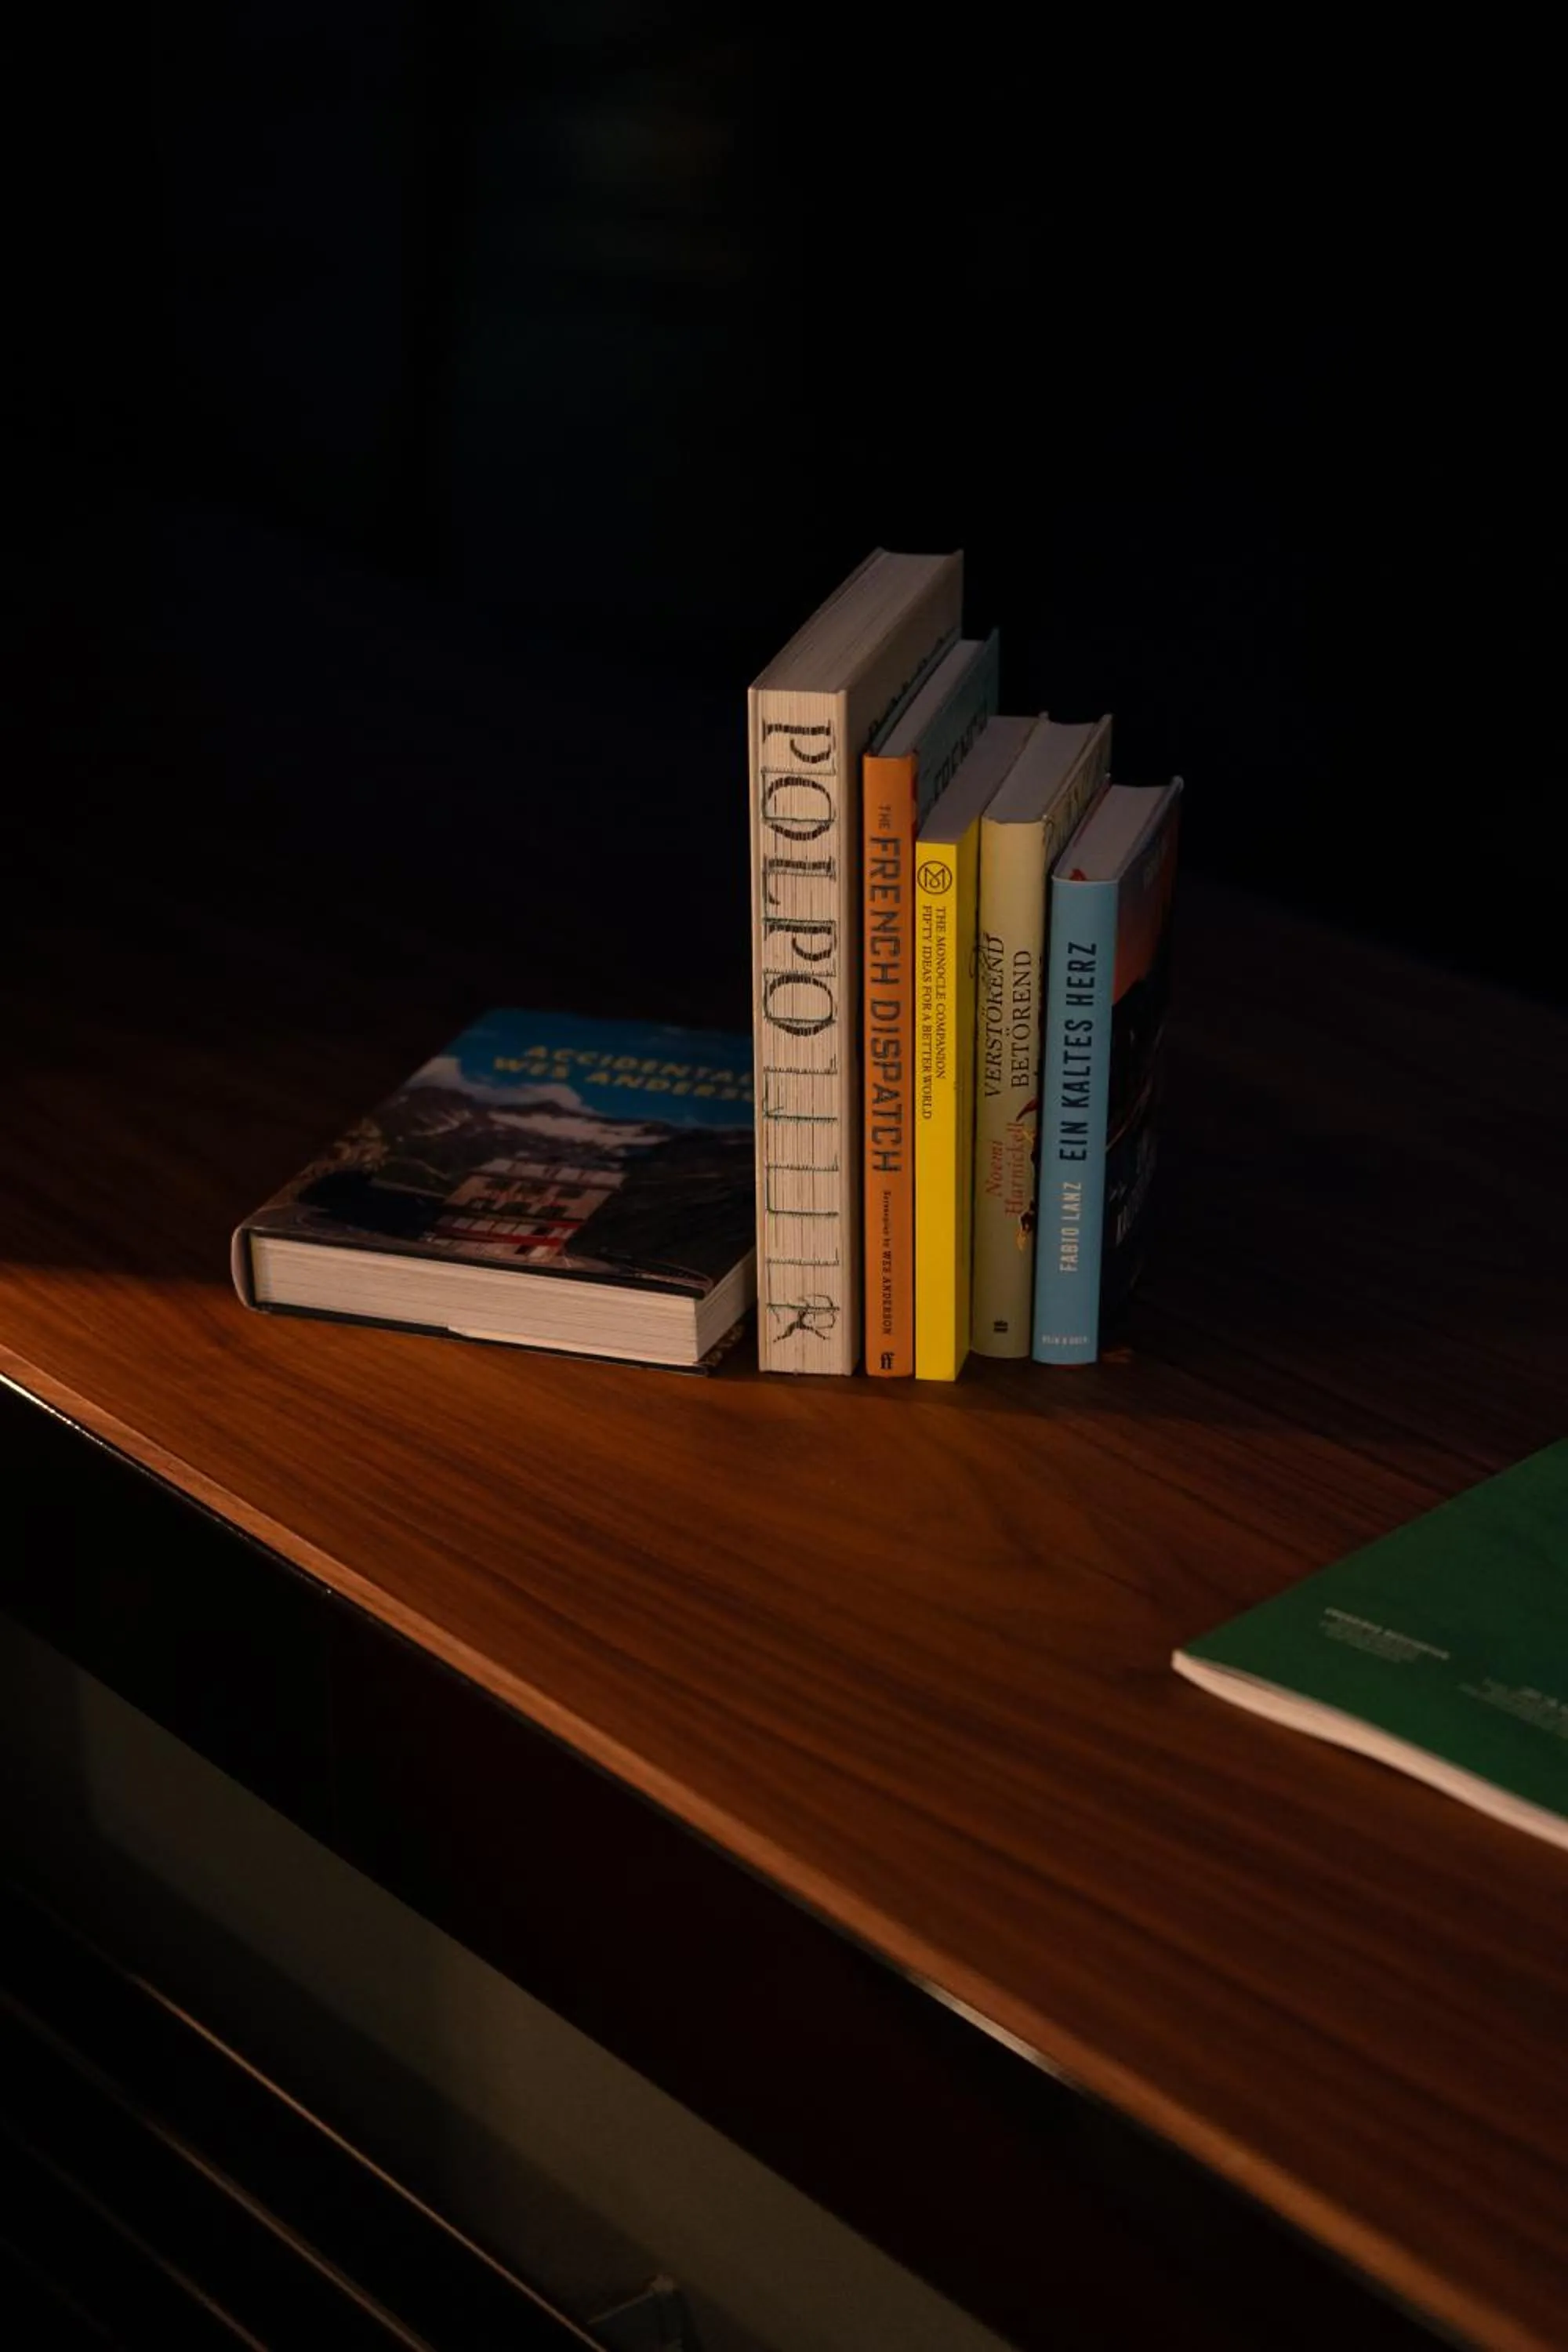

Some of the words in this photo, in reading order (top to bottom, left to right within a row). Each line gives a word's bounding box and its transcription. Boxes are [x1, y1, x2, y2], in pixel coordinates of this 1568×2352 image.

[877, 804, 891, 829] THE
[761, 719, 837, 1036] POLPO
[869, 836, 901, 985] FRENCH
[922, 905, 932, 942] FIFTY
[936, 906, 947, 932] THE
[922, 946, 932, 983] IDEAS
[935, 935, 946, 1001] MONOCLE
[1065, 942, 1097, 1006] HERZ
[922, 985, 932, 1012] FOR
[922, 1012, 931, 1022] A
[982, 934, 1004, 1097] VERSTÖREND
[1007, 950, 1031, 1087] BETÖREND
[921, 1024, 931, 1073] BETTER
[935, 1003, 946, 1079] COMPANION
[1062, 1019, 1094, 1108] KALTES
[871, 999, 902, 1173] DISPATCH
[921, 1075, 931, 1120] WORLD
[1060, 1120, 1088, 1161] EIN
[1061, 1181, 1082, 1221] LANZ
[1059, 1226, 1080, 1272] FABIO
